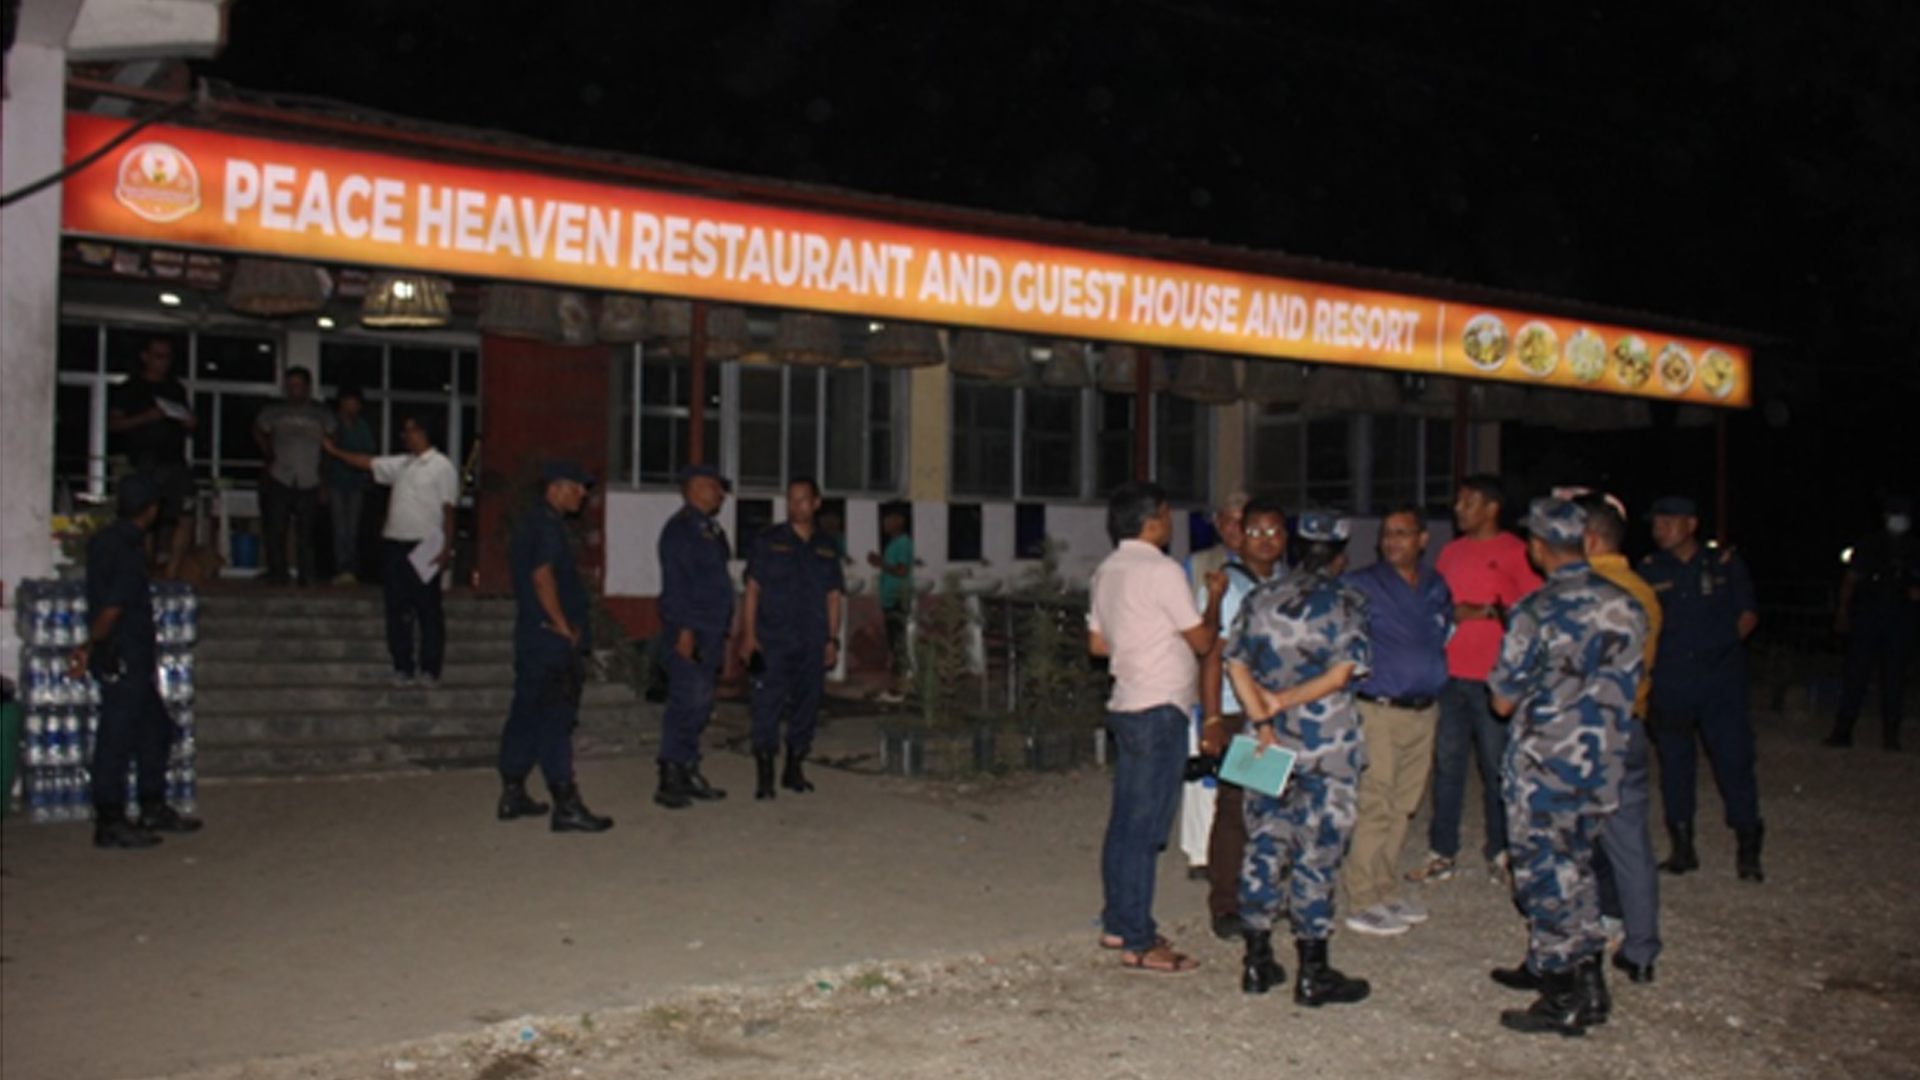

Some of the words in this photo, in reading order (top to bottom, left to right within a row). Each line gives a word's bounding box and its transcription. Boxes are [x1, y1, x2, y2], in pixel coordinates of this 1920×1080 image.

[224, 159, 406, 244] PEACE
[416, 184, 622, 268] HEAVEN
[630, 211, 915, 300] RESTAURANT
[918, 249, 1004, 309] AND
[1010, 260, 1127, 321] GUEST
[1130, 275, 1241, 335] HOUSE
[1241, 291, 1308, 341] AND
[1312, 299, 1420, 352] RESORT
